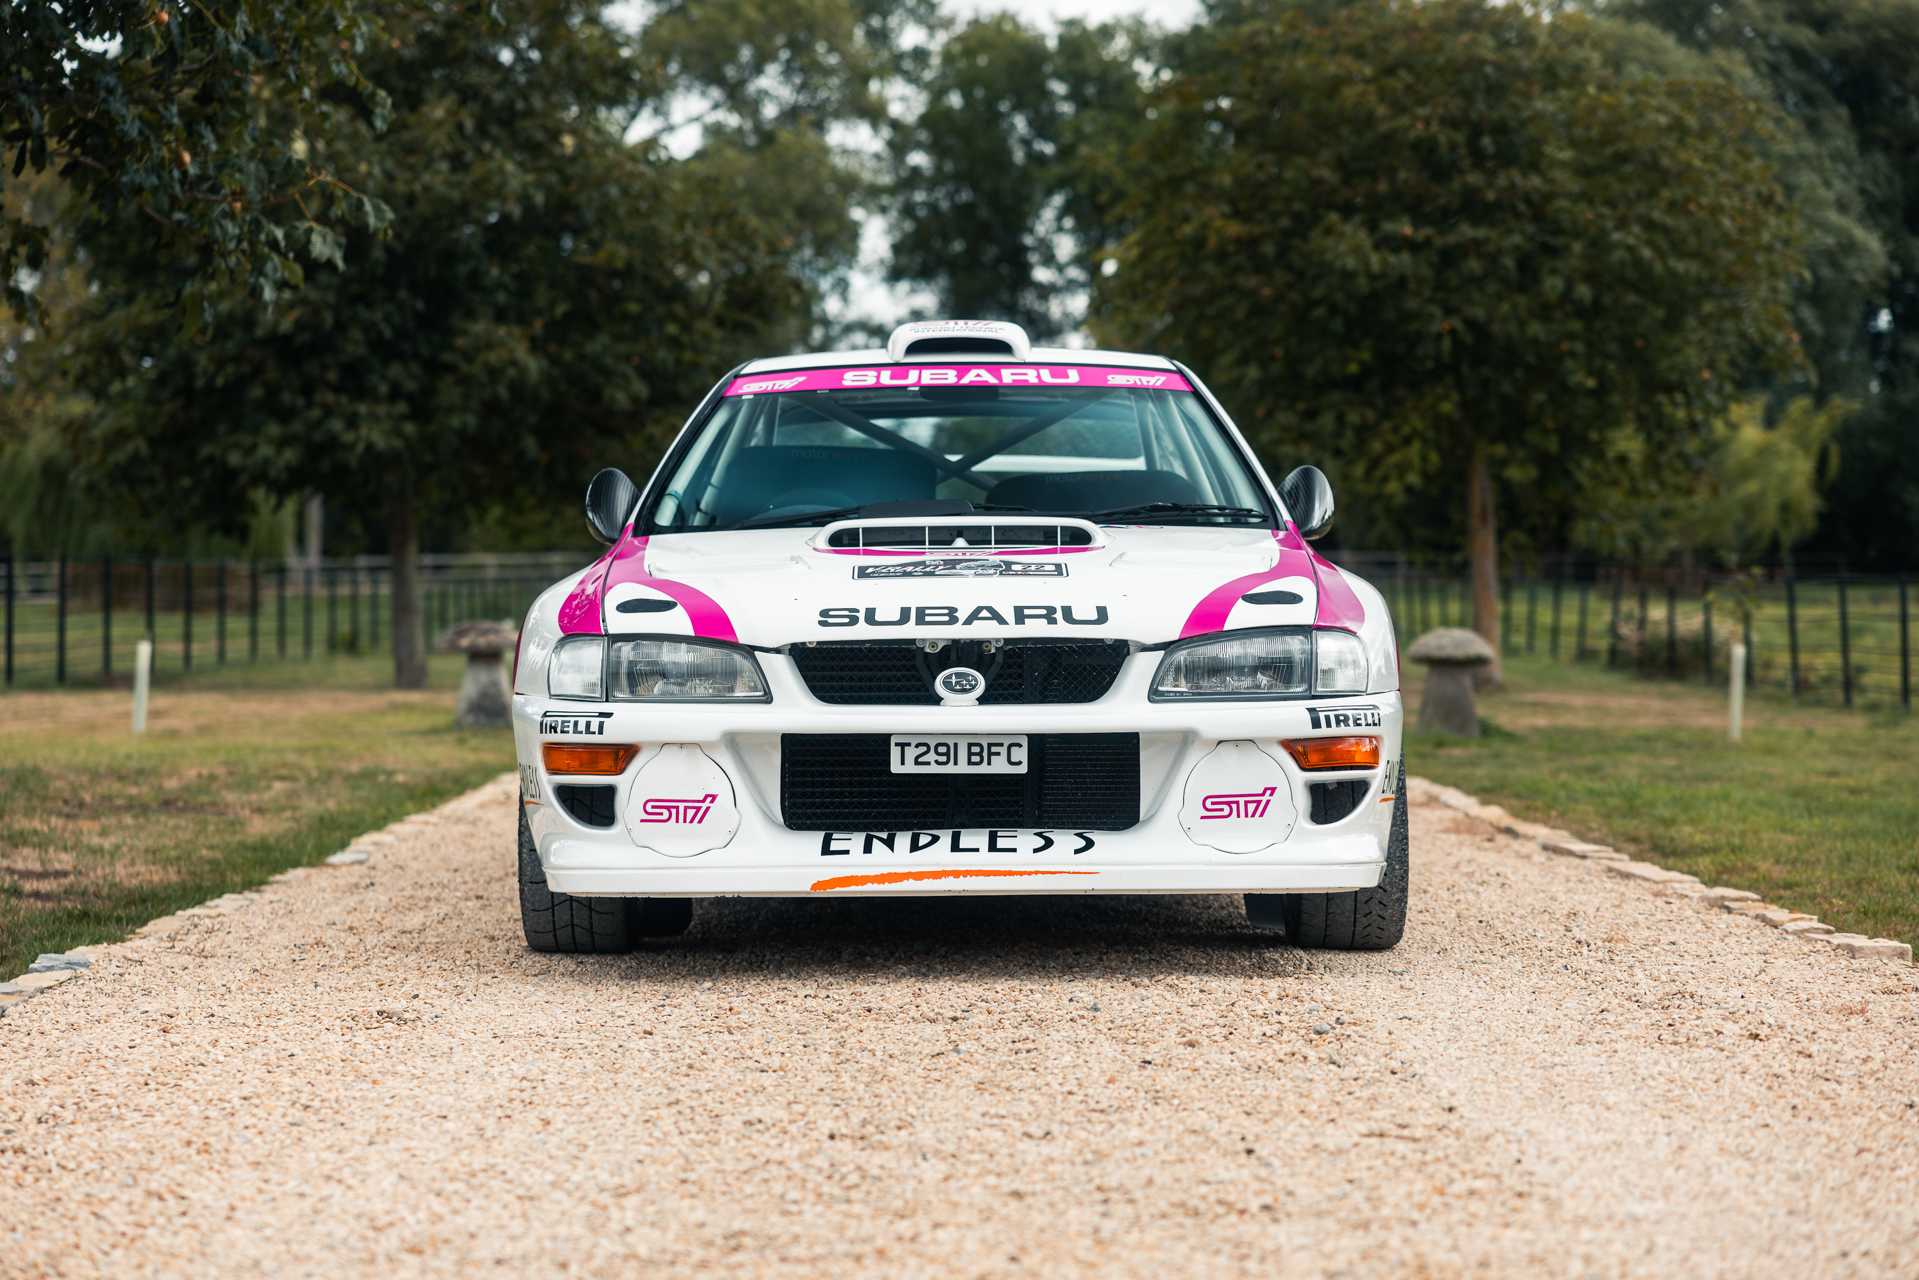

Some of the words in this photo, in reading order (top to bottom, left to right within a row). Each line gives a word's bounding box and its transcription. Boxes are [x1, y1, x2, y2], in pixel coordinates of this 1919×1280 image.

[842, 368, 1080, 386] SUBARU
[817, 605, 1109, 628] SUBARU
[539, 711, 614, 736] PIRELLI
[1305, 705, 1382, 730] PIRELLI
[894, 742, 959, 767] T291
[967, 742, 1024, 767] BFC
[820, 829, 1096, 856] ENDLESS
